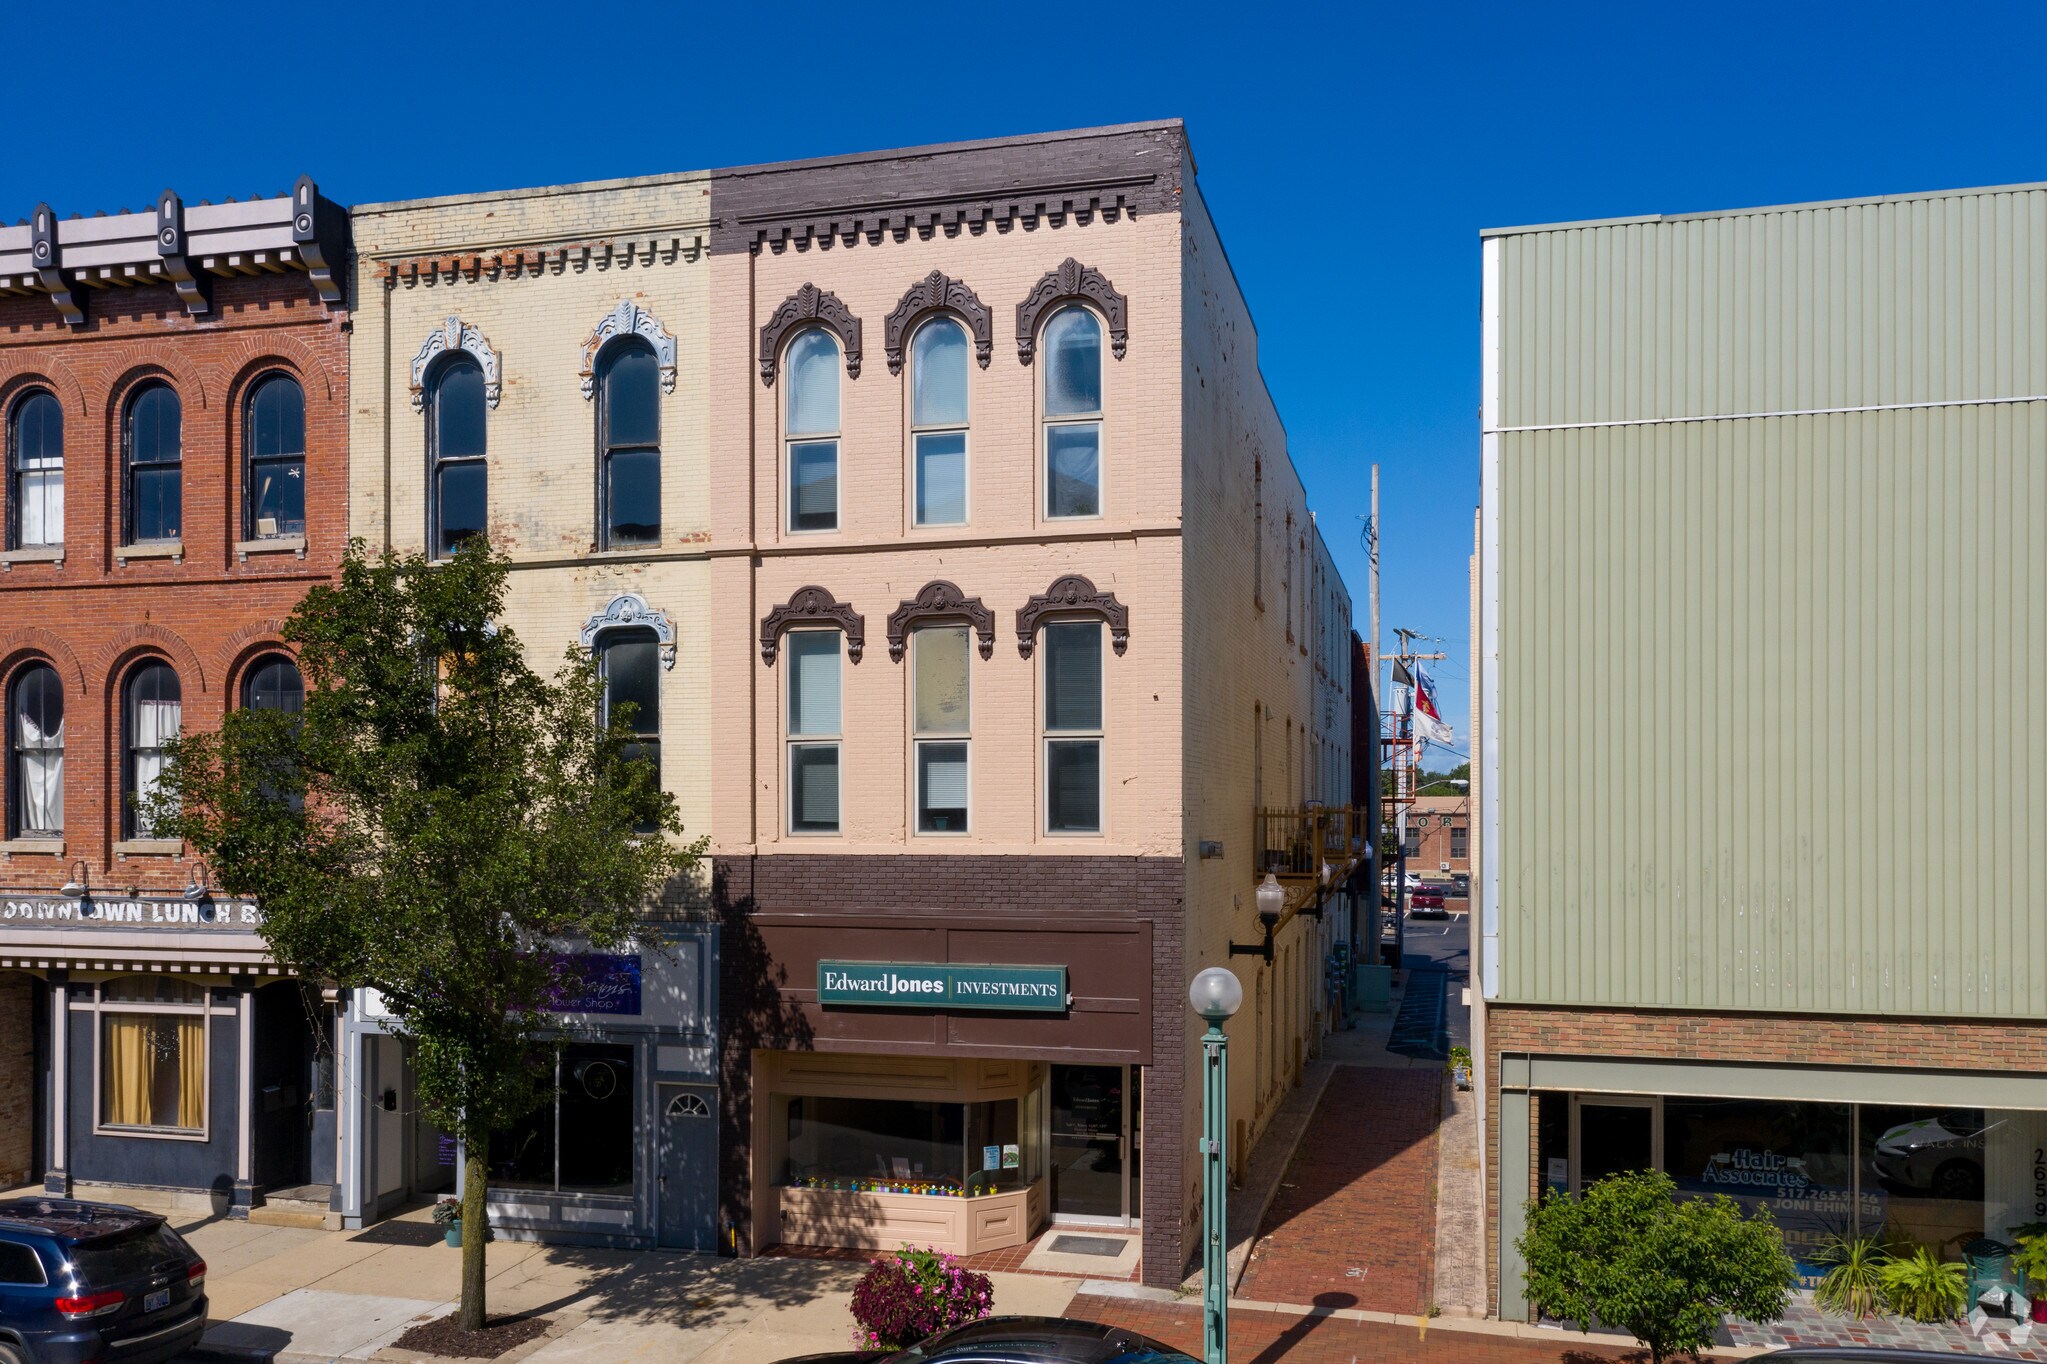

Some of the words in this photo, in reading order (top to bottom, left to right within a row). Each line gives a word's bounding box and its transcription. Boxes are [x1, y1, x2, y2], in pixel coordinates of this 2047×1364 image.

[4, 901, 142, 922] DOWNTOWN
[152, 903, 231, 923] LUNCH
[956, 981, 1057, 997] INVESTMENTS
[551, 996, 581, 1007] lower
[585, 996, 614, 1009] Shop
[1732, 1149, 1786, 1171] Hair
[1703, 1159, 1809, 1187] Associates
[1777, 1187, 1879, 1204] 517.265.926
[1772, 1199, 1810, 1212] JONI
[1814, 1200, 1882, 1217] EHINER
